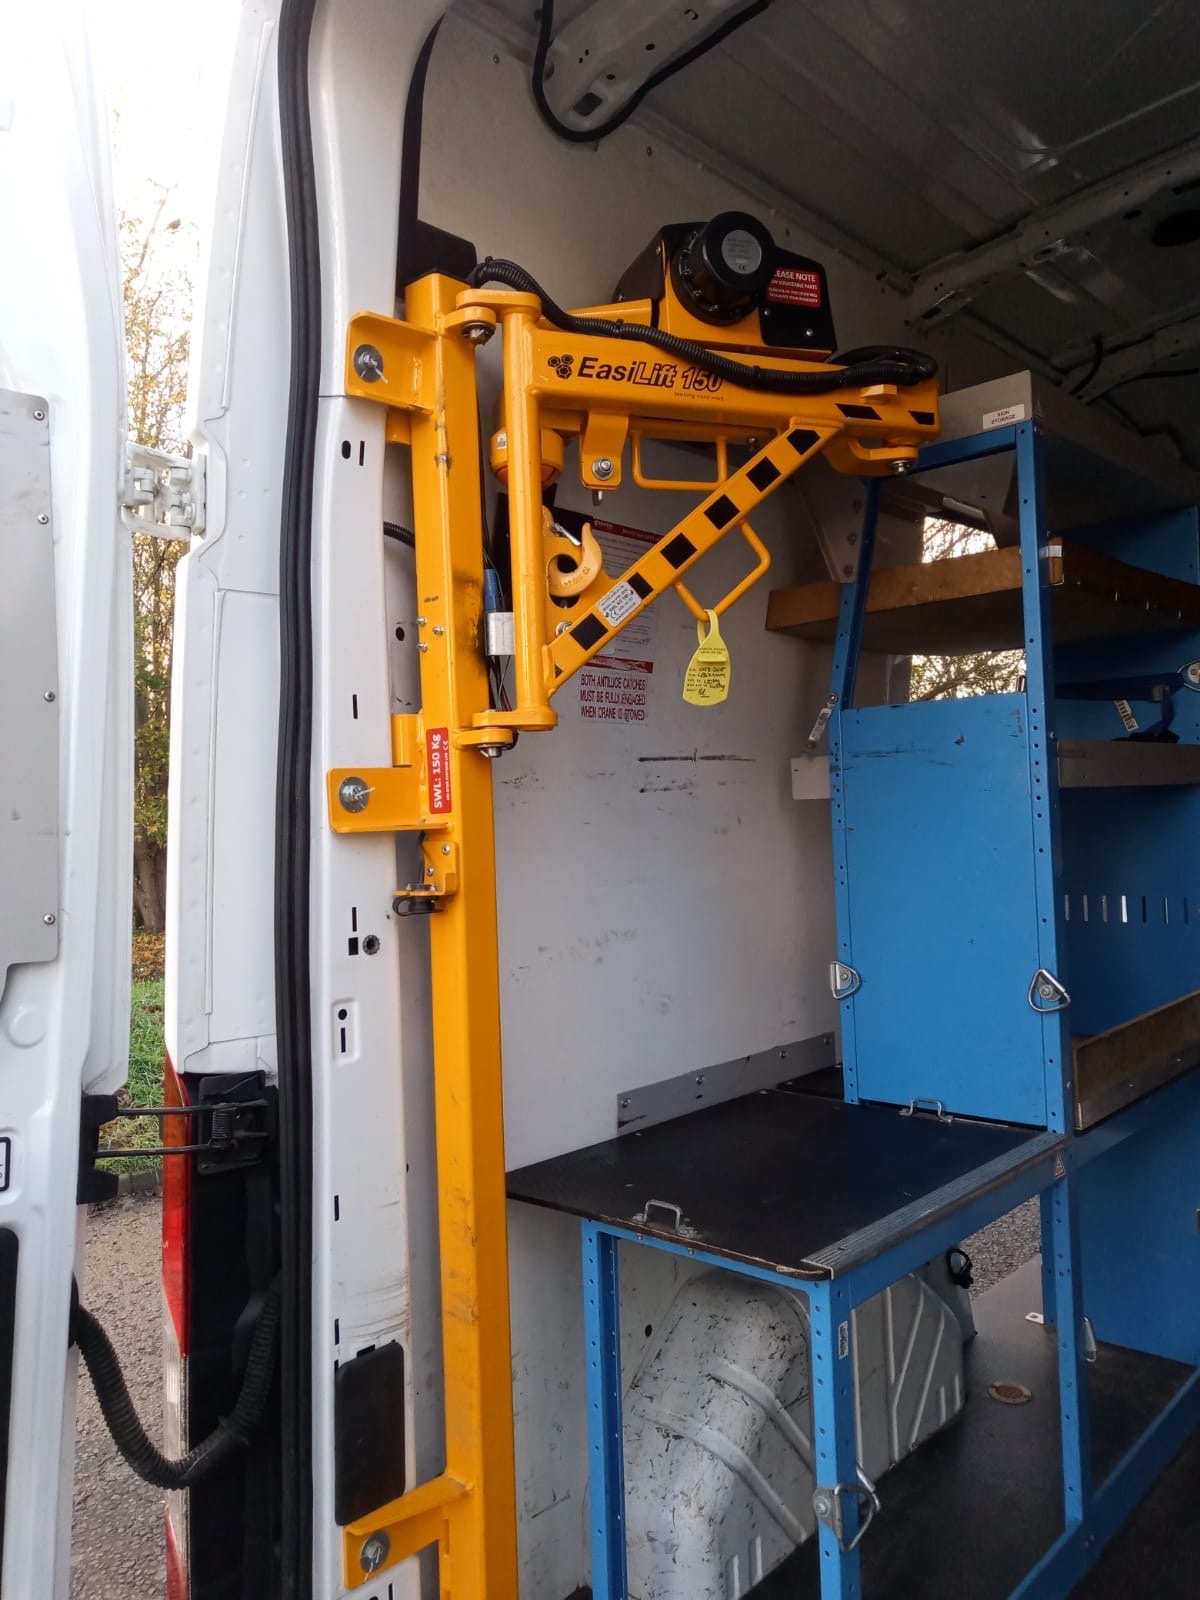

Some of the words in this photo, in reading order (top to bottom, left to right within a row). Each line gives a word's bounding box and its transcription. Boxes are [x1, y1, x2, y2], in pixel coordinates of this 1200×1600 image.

[795, 273, 816, 283] NOTE
[577, 356, 678, 388] EasiLift
[682, 365, 723, 393] 150
[581, 674, 596, 686] BOTH
[597, 675, 622, 689] ANTILUCE
[622, 677, 646, 691] CATCHES
[580, 690, 595, 702] MUST
[596, 691, 604, 703] BE
[605, 692, 620, 704] FULLY
[621, 693, 645, 706] ENGAGED
[581, 706, 597, 718] WHEN
[598, 707, 616, 720] CRANE
[617, 708, 623, 720] IS
[624, 708, 645, 721] STOWED
[431, 734, 441, 749] Kg
[432, 752, 441, 775] 150
[433, 778, 443, 809] SWL:
